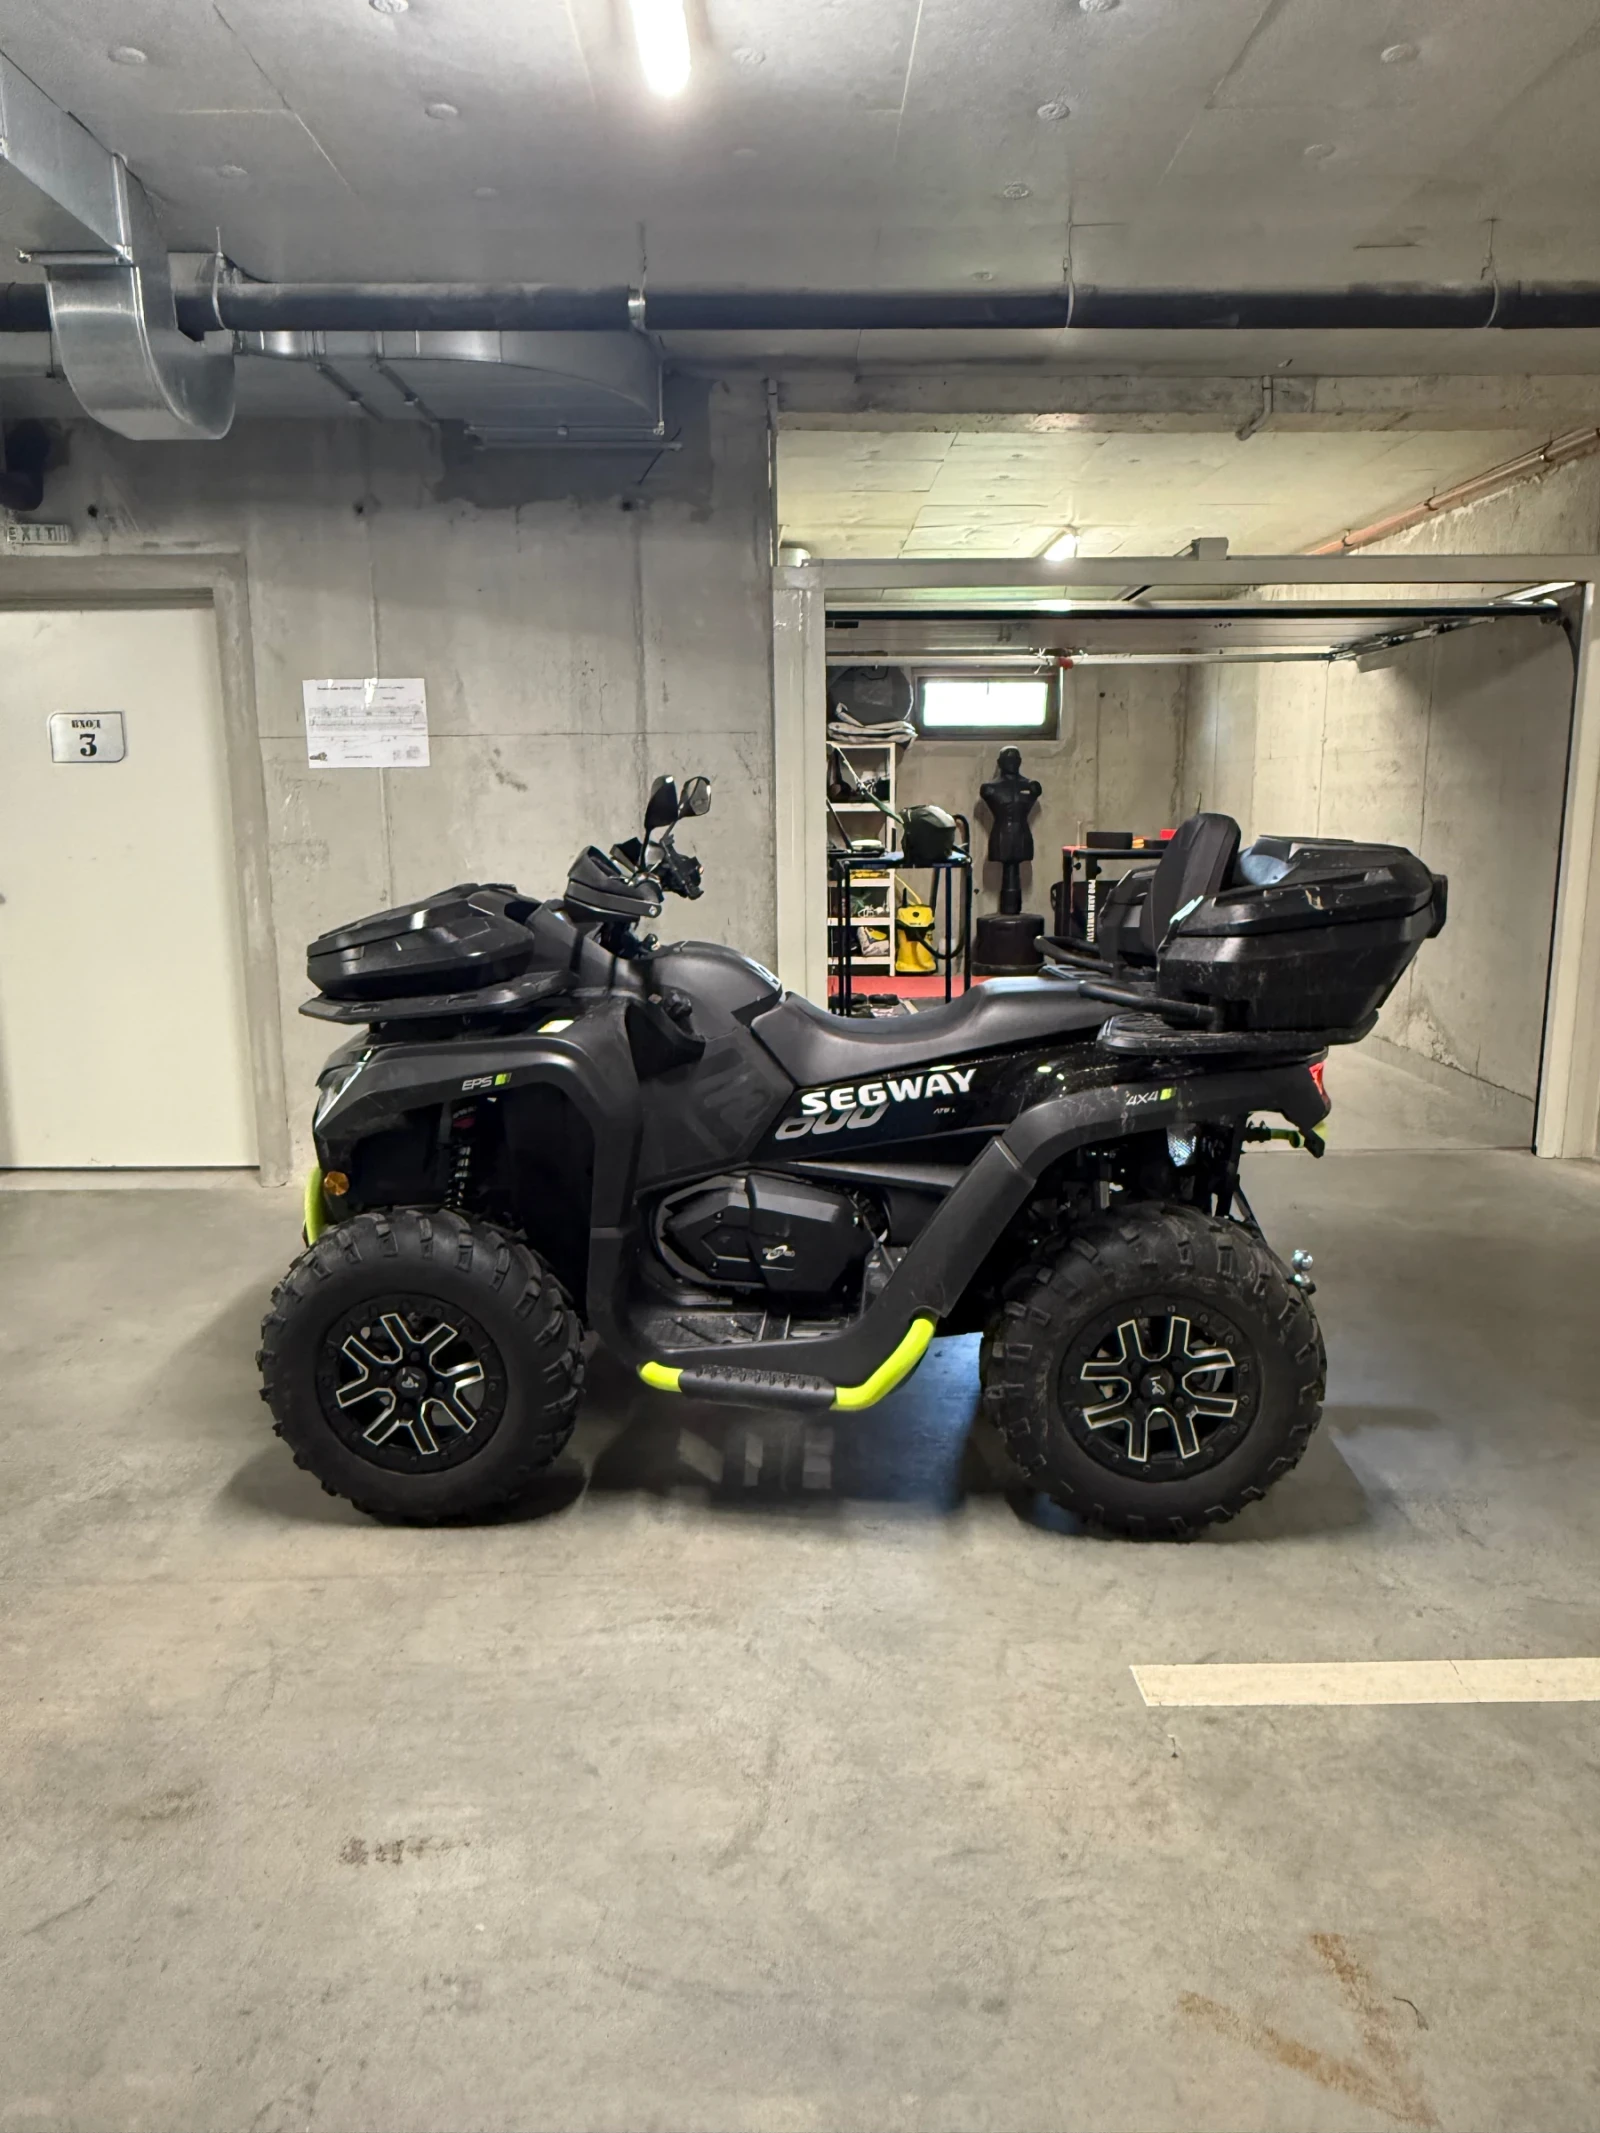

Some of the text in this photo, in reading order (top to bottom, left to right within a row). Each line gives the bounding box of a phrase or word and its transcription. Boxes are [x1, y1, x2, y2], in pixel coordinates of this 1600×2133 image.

[7, 526, 55, 541] EXIT
[79, 733, 98, 757] 3
[461, 1075, 493, 1091] EPS
[801, 1068, 977, 1116] SEGWAY
